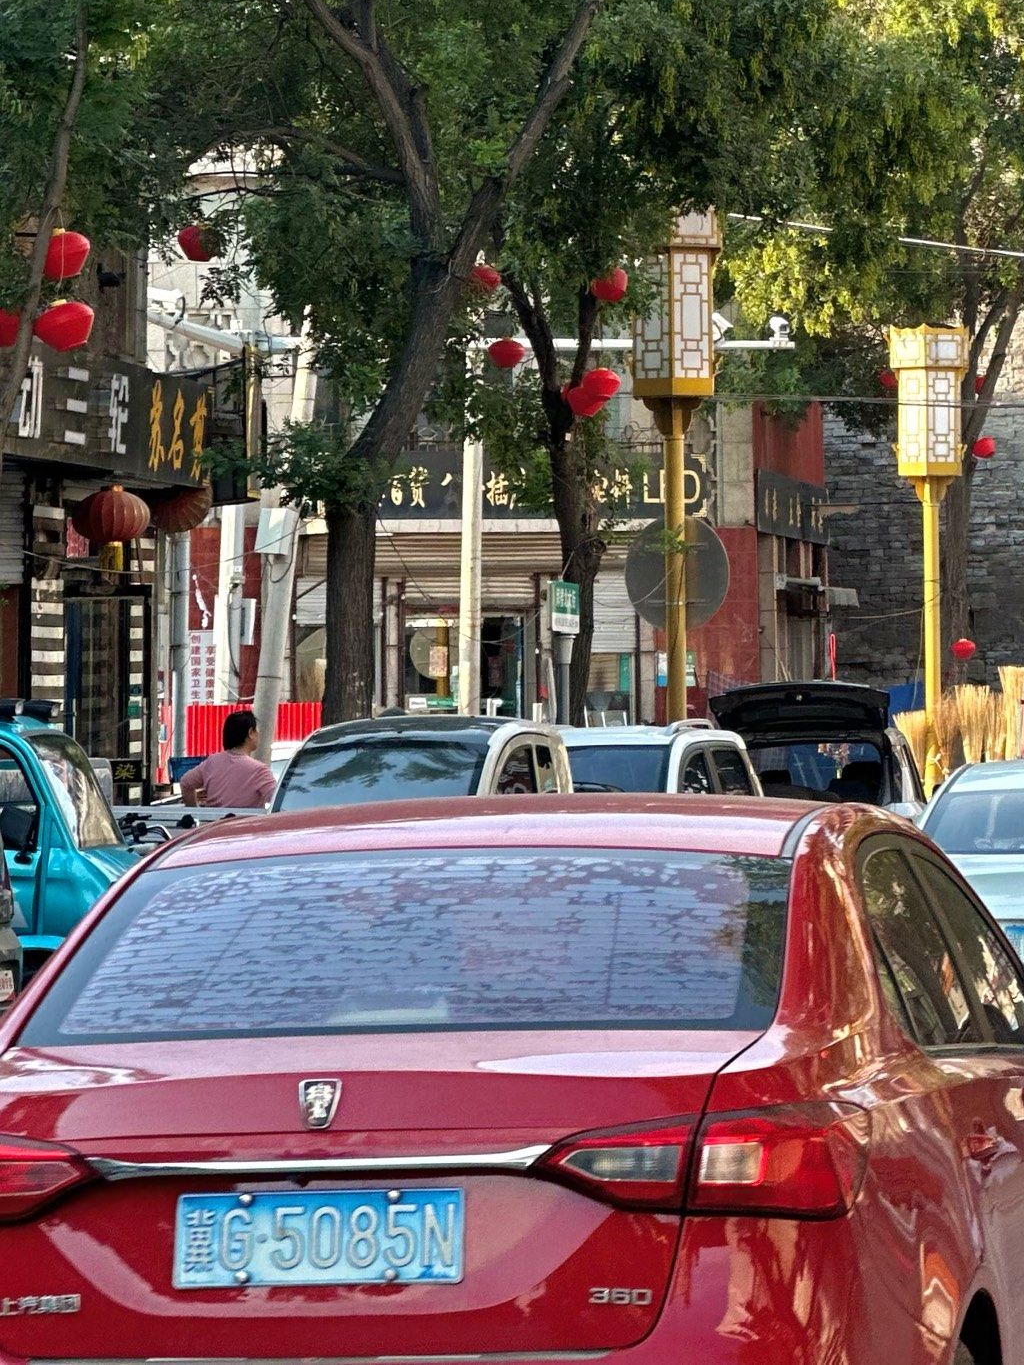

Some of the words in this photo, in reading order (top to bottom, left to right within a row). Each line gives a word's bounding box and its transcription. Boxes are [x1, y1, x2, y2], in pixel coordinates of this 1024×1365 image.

[191, 634, 201, 705] 创建国家卫生
[205, 646, 215, 705] 享受健康美
[588, 1287, 653, 1306] 360
